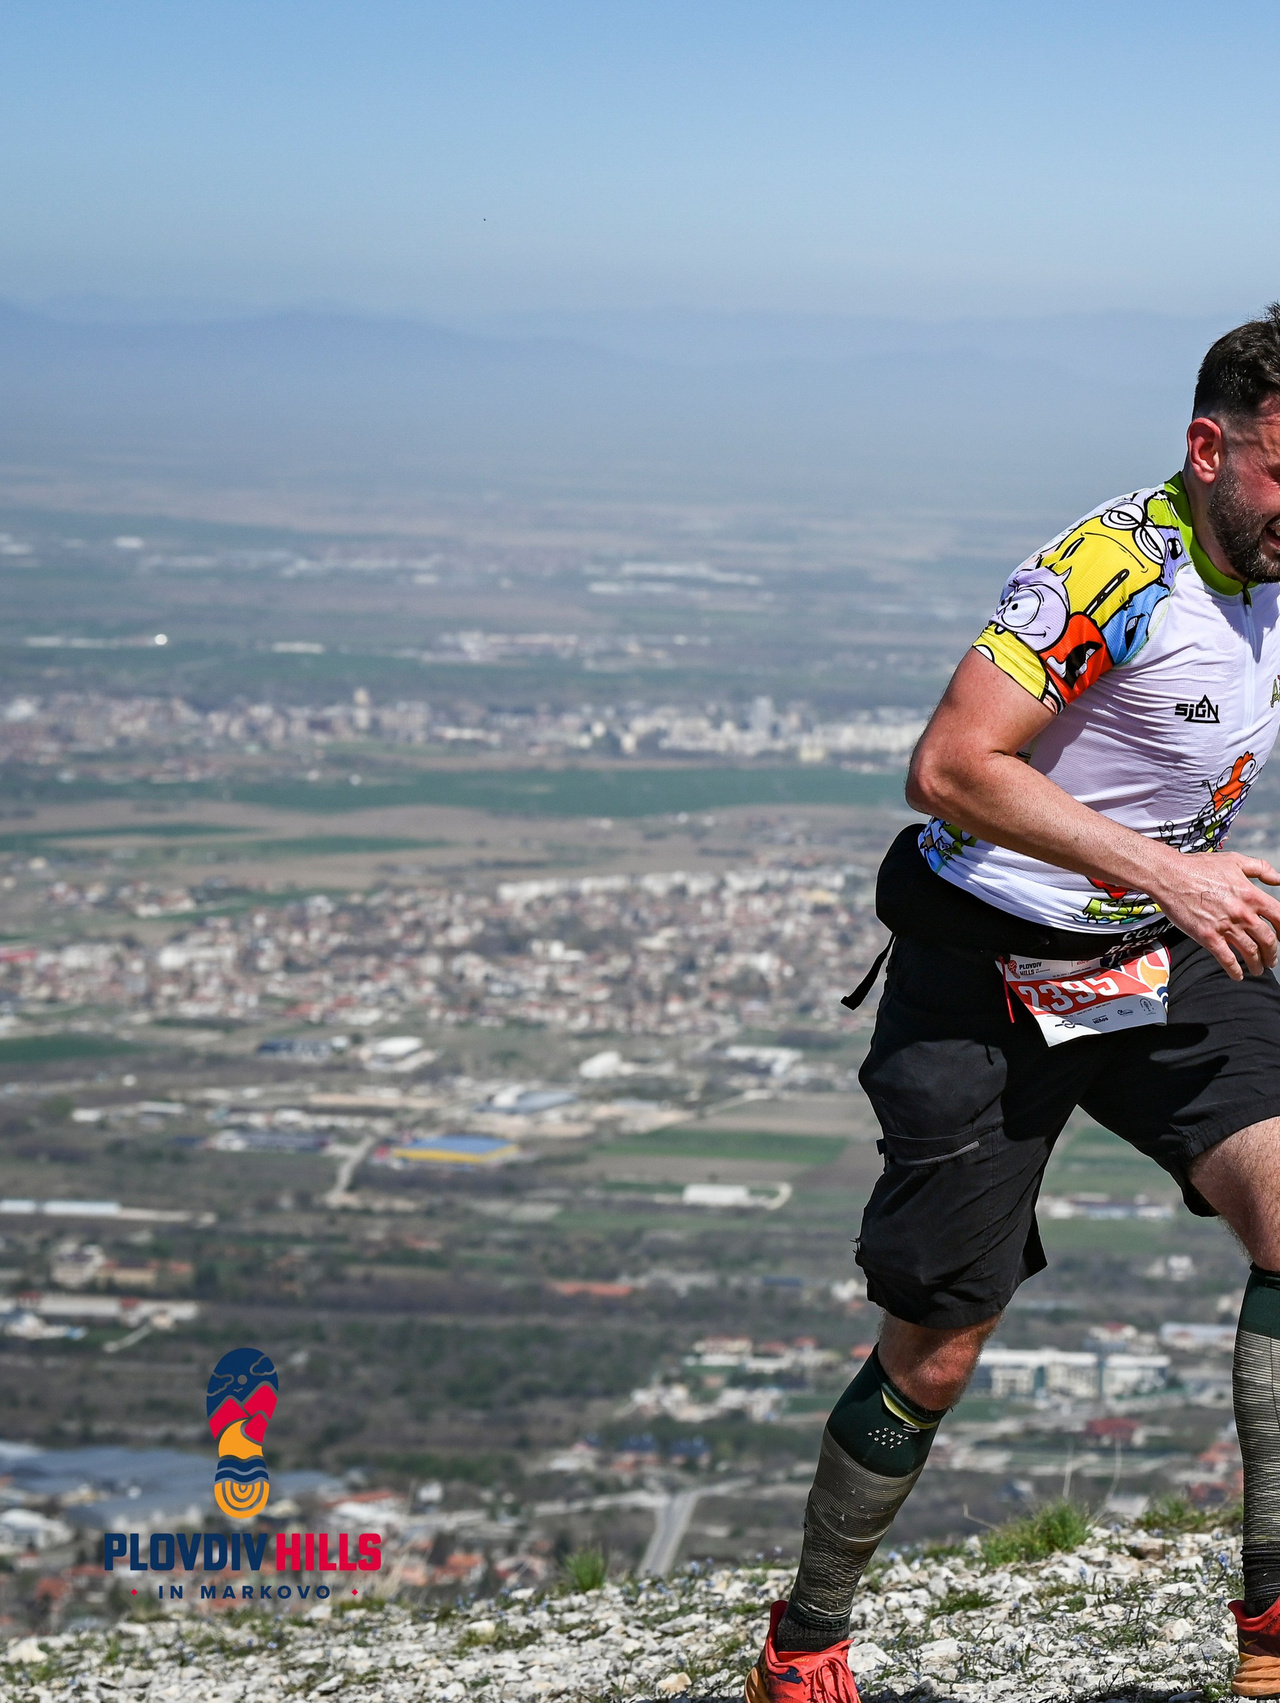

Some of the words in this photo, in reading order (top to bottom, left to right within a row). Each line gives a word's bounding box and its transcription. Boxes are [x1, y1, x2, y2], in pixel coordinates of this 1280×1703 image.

[1122, 923, 1175, 941] COMP
[1018, 961, 1043, 971] PLOVDIV
[1019, 969, 1035, 977] HILLS
[1017, 972, 1120, 1012] 2395
